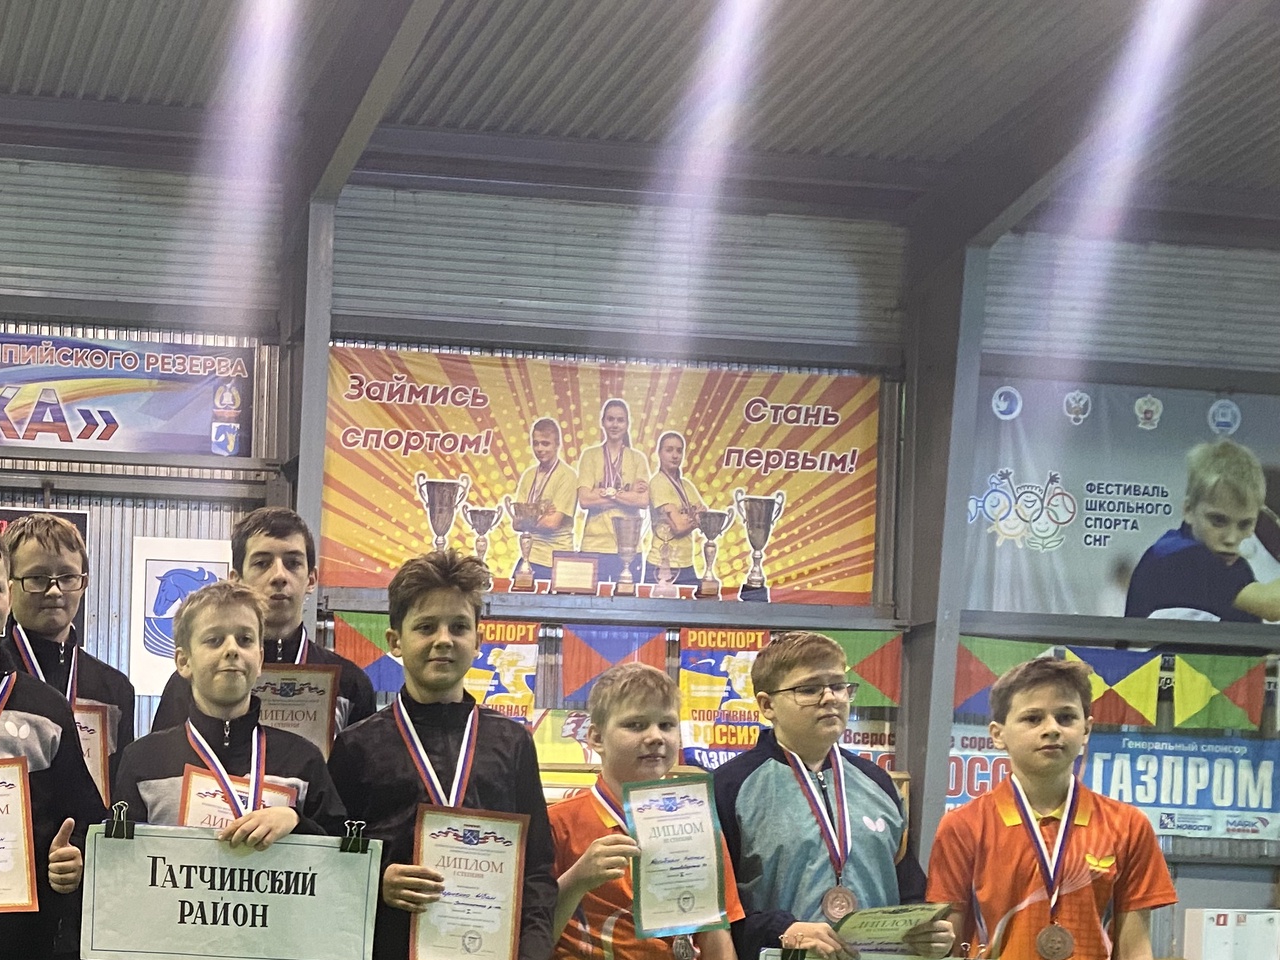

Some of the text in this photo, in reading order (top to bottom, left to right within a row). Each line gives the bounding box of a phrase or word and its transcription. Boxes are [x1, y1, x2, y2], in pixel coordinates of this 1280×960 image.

[145, 353, 248, 379] РЕЗЕРВА
[344, 374, 489, 409] Займись
[744, 397, 841, 427] Стань
[340, 425, 493, 456] спортом!
[725, 445, 858, 475] первым!
[1085, 482, 1169, 499] ФЕСТИВАЛЬ
[1084, 499, 1173, 516] ШКОЛЬНОГО
[1084, 517, 1140, 532] СПОРТА
[1083, 533, 1111, 547] СНГ
[688, 630, 765, 648] РОССПОРТ
[691, 709, 760, 722] СПОРТИВНАЯ
[693, 724, 760, 745] РОССИЯ
[1122, 738, 1248, 755] Генеральный спонсор
[1092, 751, 1274, 808] ГАЗПРОМ
[649, 822, 705, 839] ДИПЛОМ
[435, 855, 504, 874] ДИПЛОМ
[147, 855, 318, 897] ГАТЧИНСКИЙ
[177, 897, 269, 928] РАЙОН
